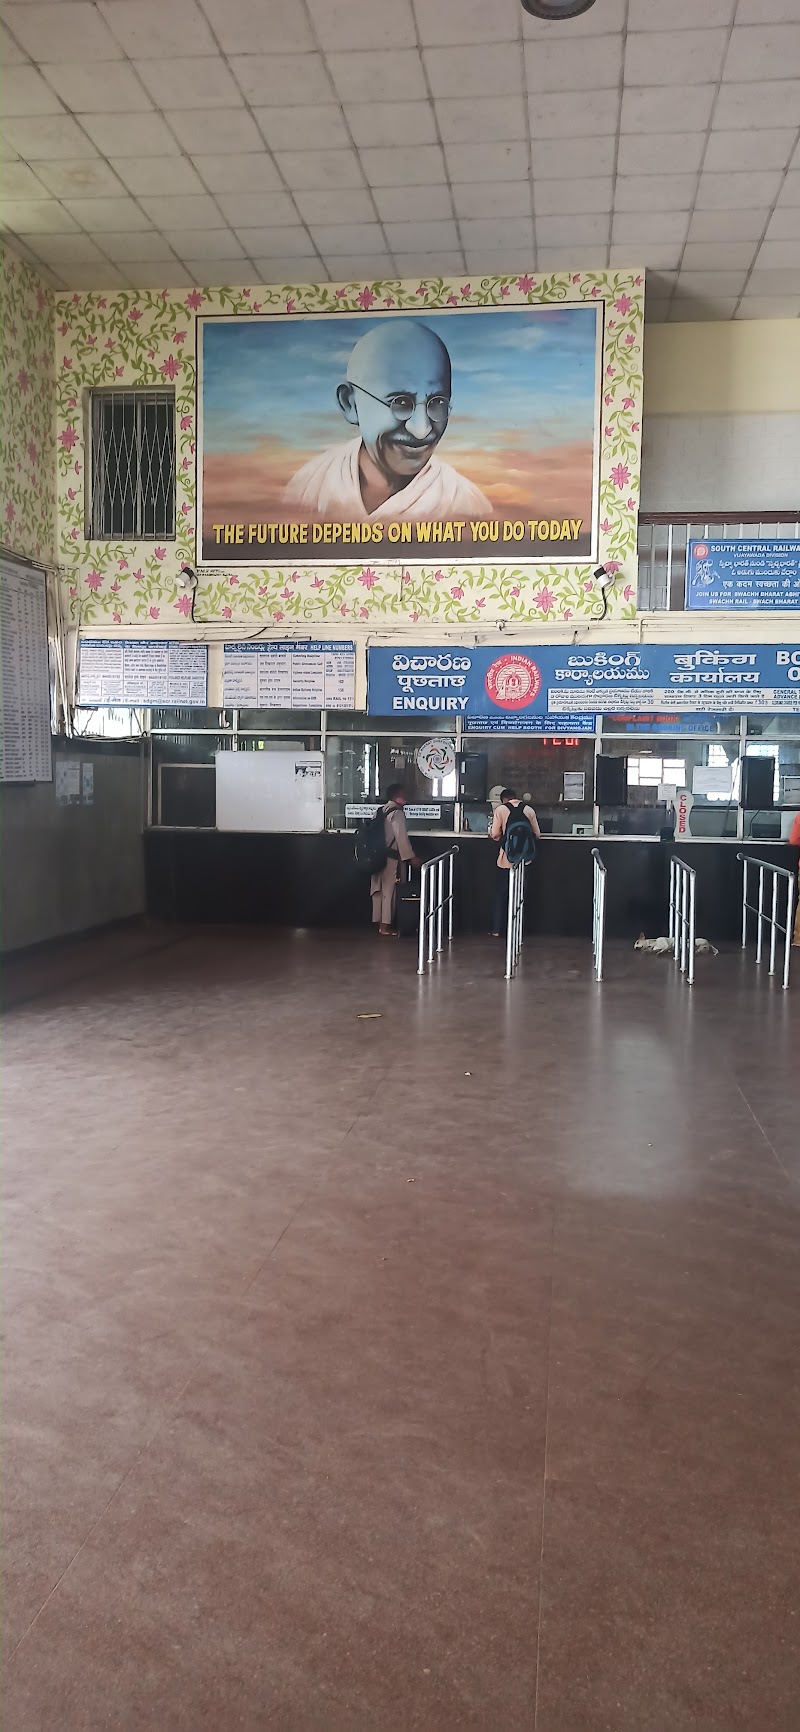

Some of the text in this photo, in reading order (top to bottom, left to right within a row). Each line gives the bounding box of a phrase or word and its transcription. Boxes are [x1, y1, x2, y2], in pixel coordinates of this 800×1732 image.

[213, 519, 582, 544] THE FUTURE DEPENDS ON WHAT YOU DO TODAY
[710, 544, 800, 552] SOUTH CENTRAL RAILWA
[722, 580, 734, 589] एक
[736, 580, 753, 588] कदम
[755, 580, 780, 588] स्वच्छता
[781, 578, 791, 588] की
[392, 653, 471, 671] విచారణ
[567, 651, 641, 666] బుకింగ్
[673, 649, 757, 671] बुकिंग
[510, 655, 540, 697] INDIAN RAILWAYS
[555, 667, 650, 686] కార్యాలయము
[669, 666, 760, 683] कार्यालय
[397, 675, 466, 693] पूछताछ
[393, 697, 469, 711] ENQUIRY
[688, 723, 713, 731] OFFICE
[679, 794, 687, 833] CLOSED
